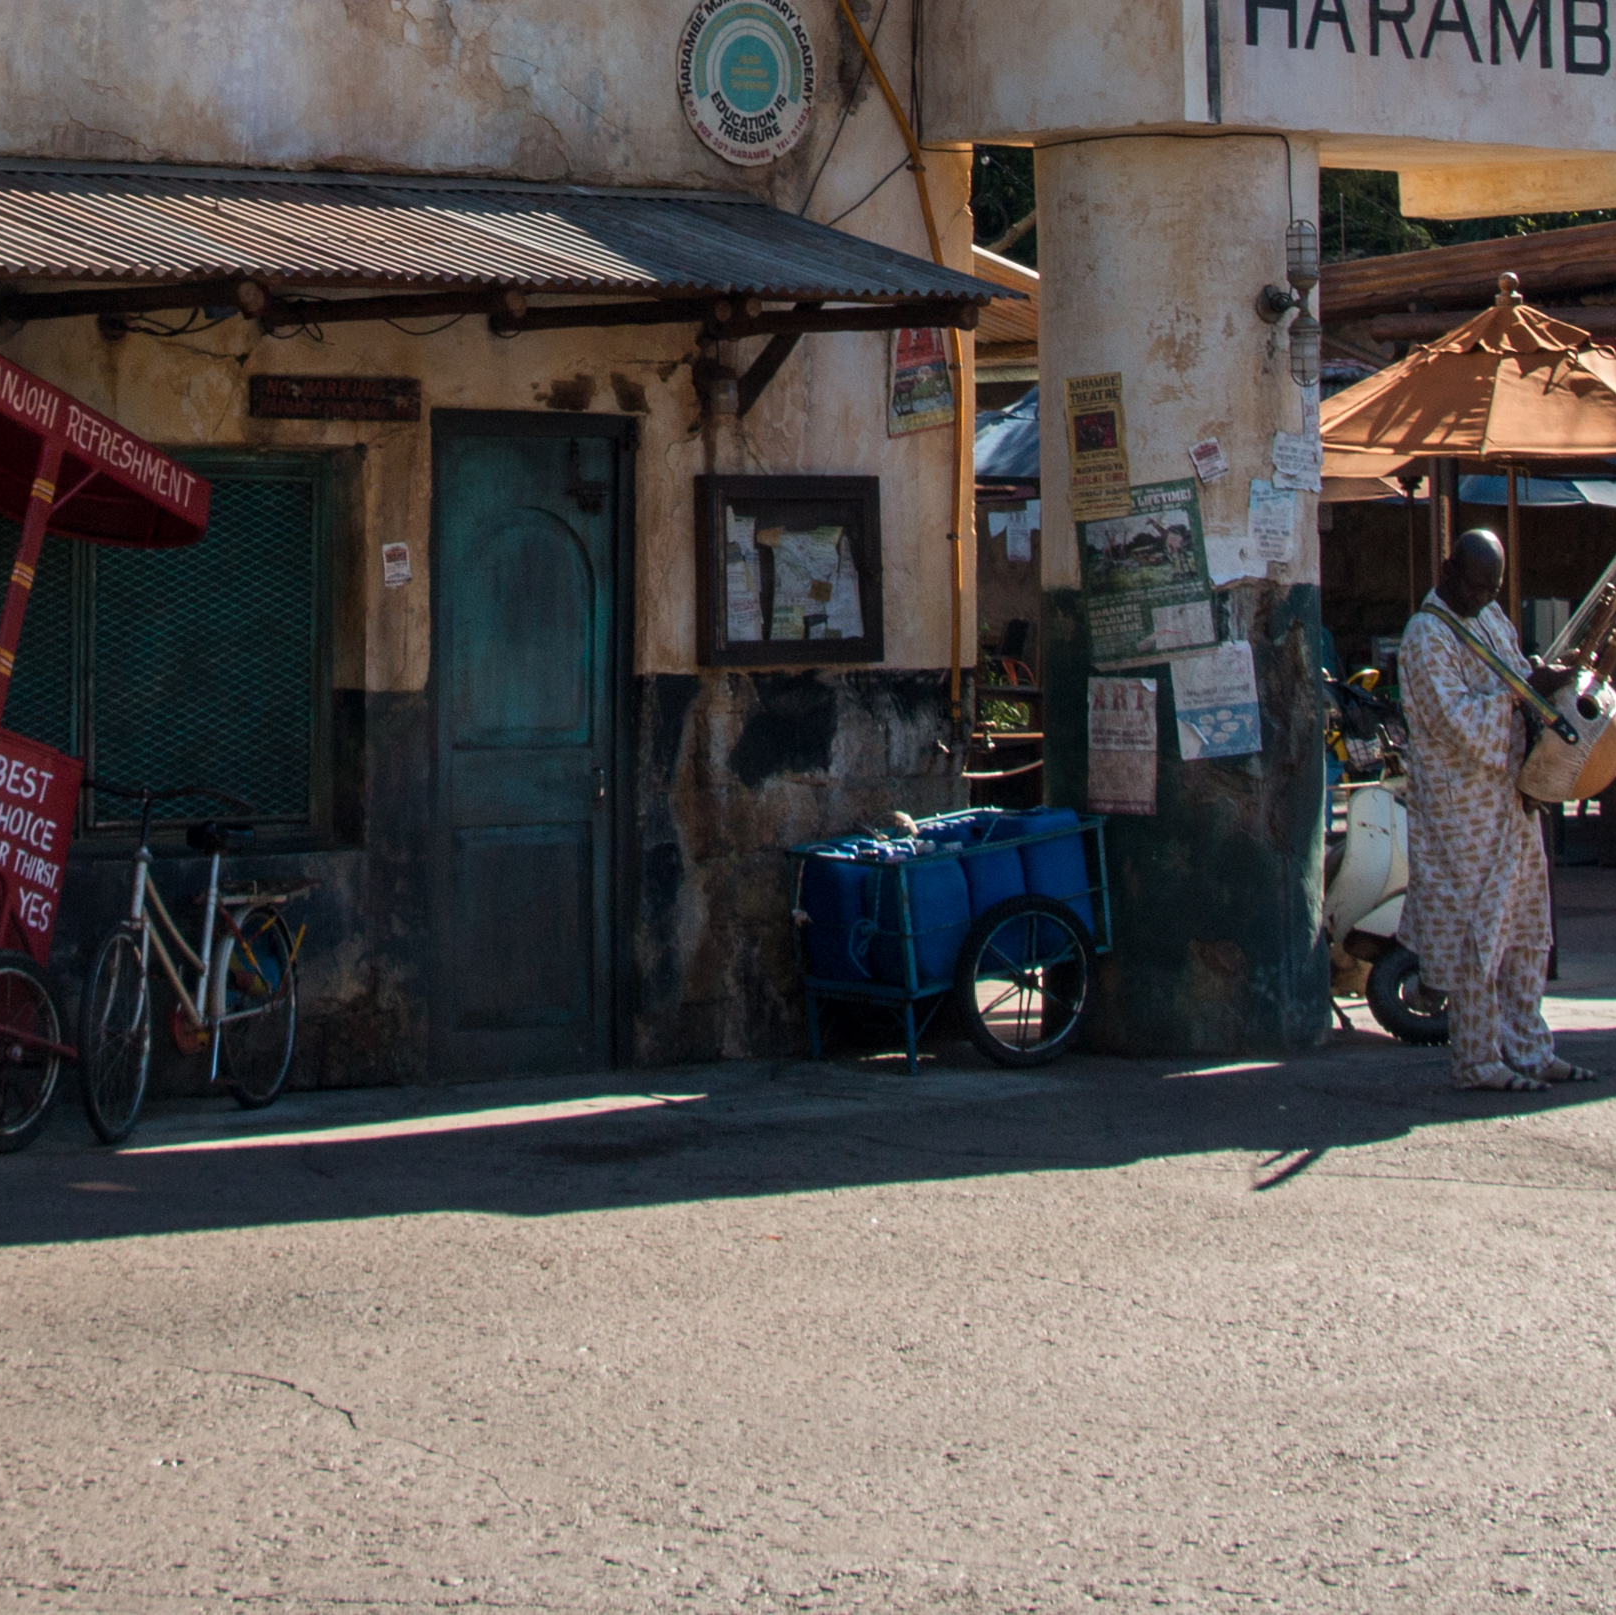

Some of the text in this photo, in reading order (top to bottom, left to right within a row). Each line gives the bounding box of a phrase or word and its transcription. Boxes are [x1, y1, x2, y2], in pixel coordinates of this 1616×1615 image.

[680, 12, 707, 95] HARAMBE
[792, 24, 814, 105] ACADEMY
[710, 91, 787, 131] EDUCATION IS
[717, 118, 782, 144] TREASURE
[65, 404, 196, 508] REFRESHMENT
[1093, 683, 1145, 711] ART
[19, 887, 52, 932] YES
